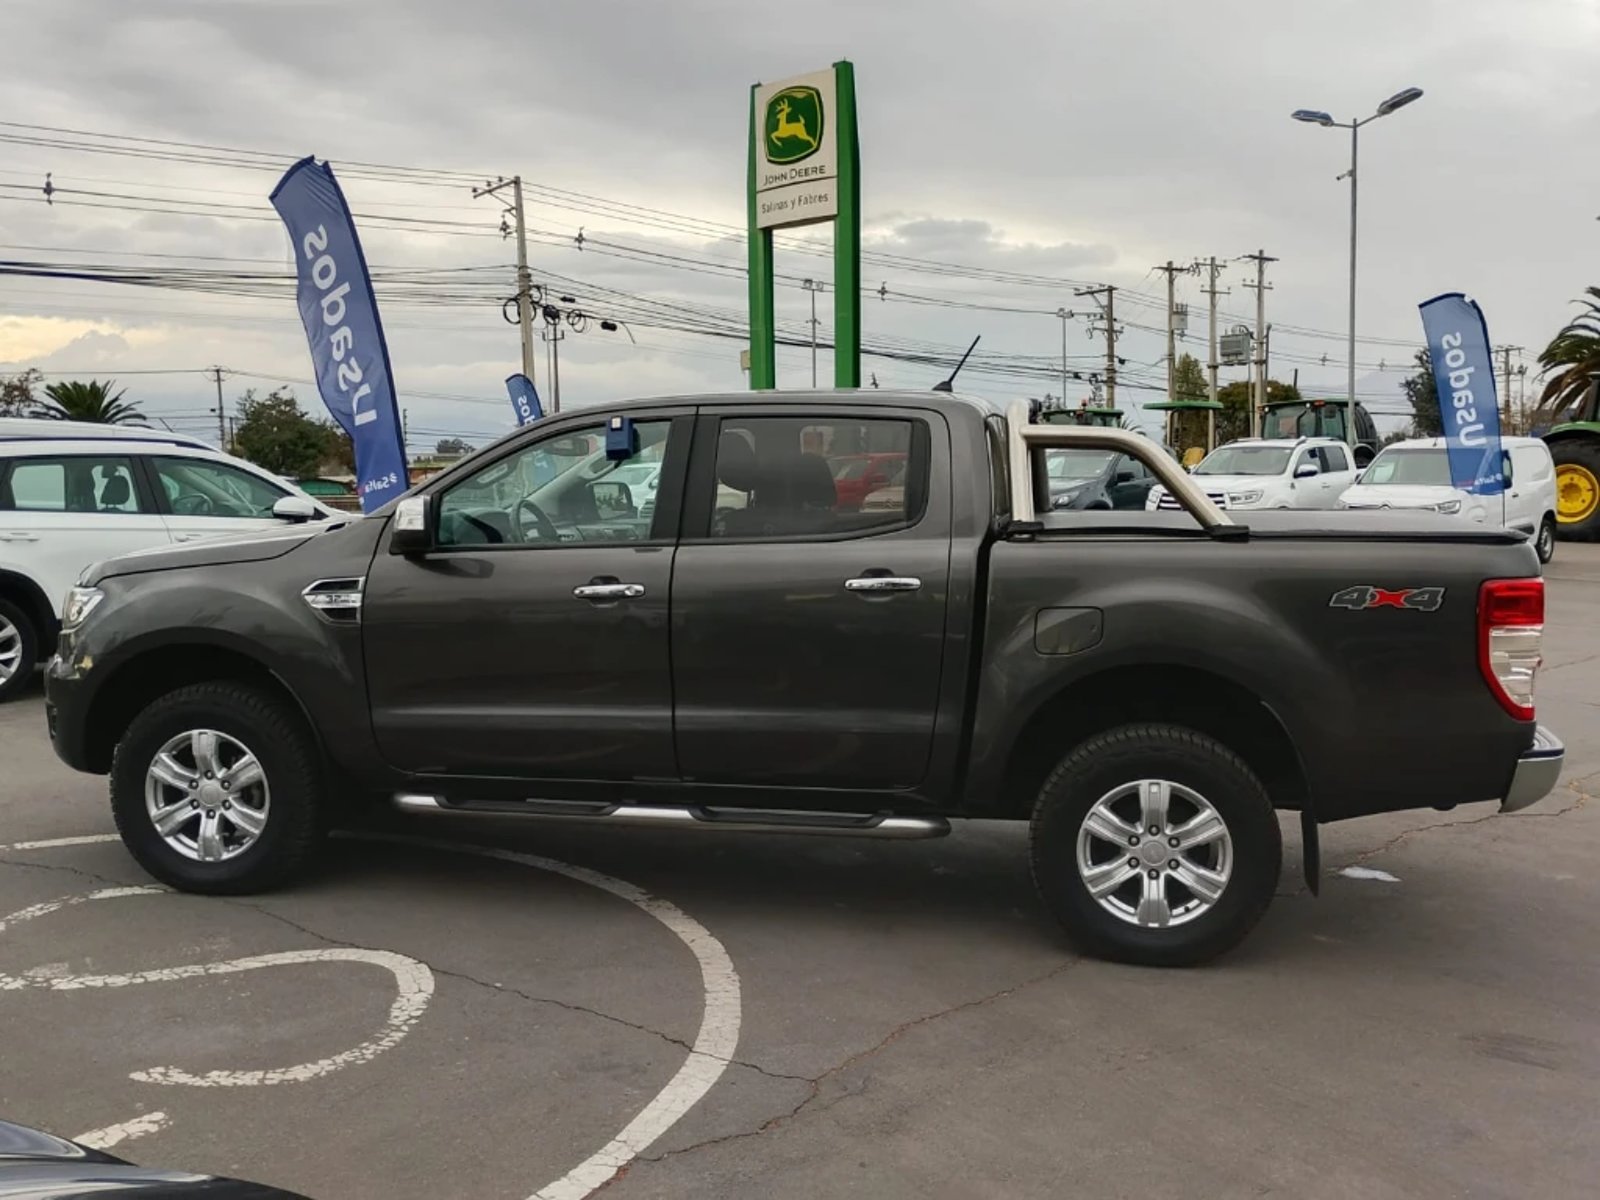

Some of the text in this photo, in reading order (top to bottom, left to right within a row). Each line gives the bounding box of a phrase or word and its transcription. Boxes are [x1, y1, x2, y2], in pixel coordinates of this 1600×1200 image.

[763, 165, 826, 186] JOHN DEERE
[761, 193, 829, 214] Salinas y Fabres
